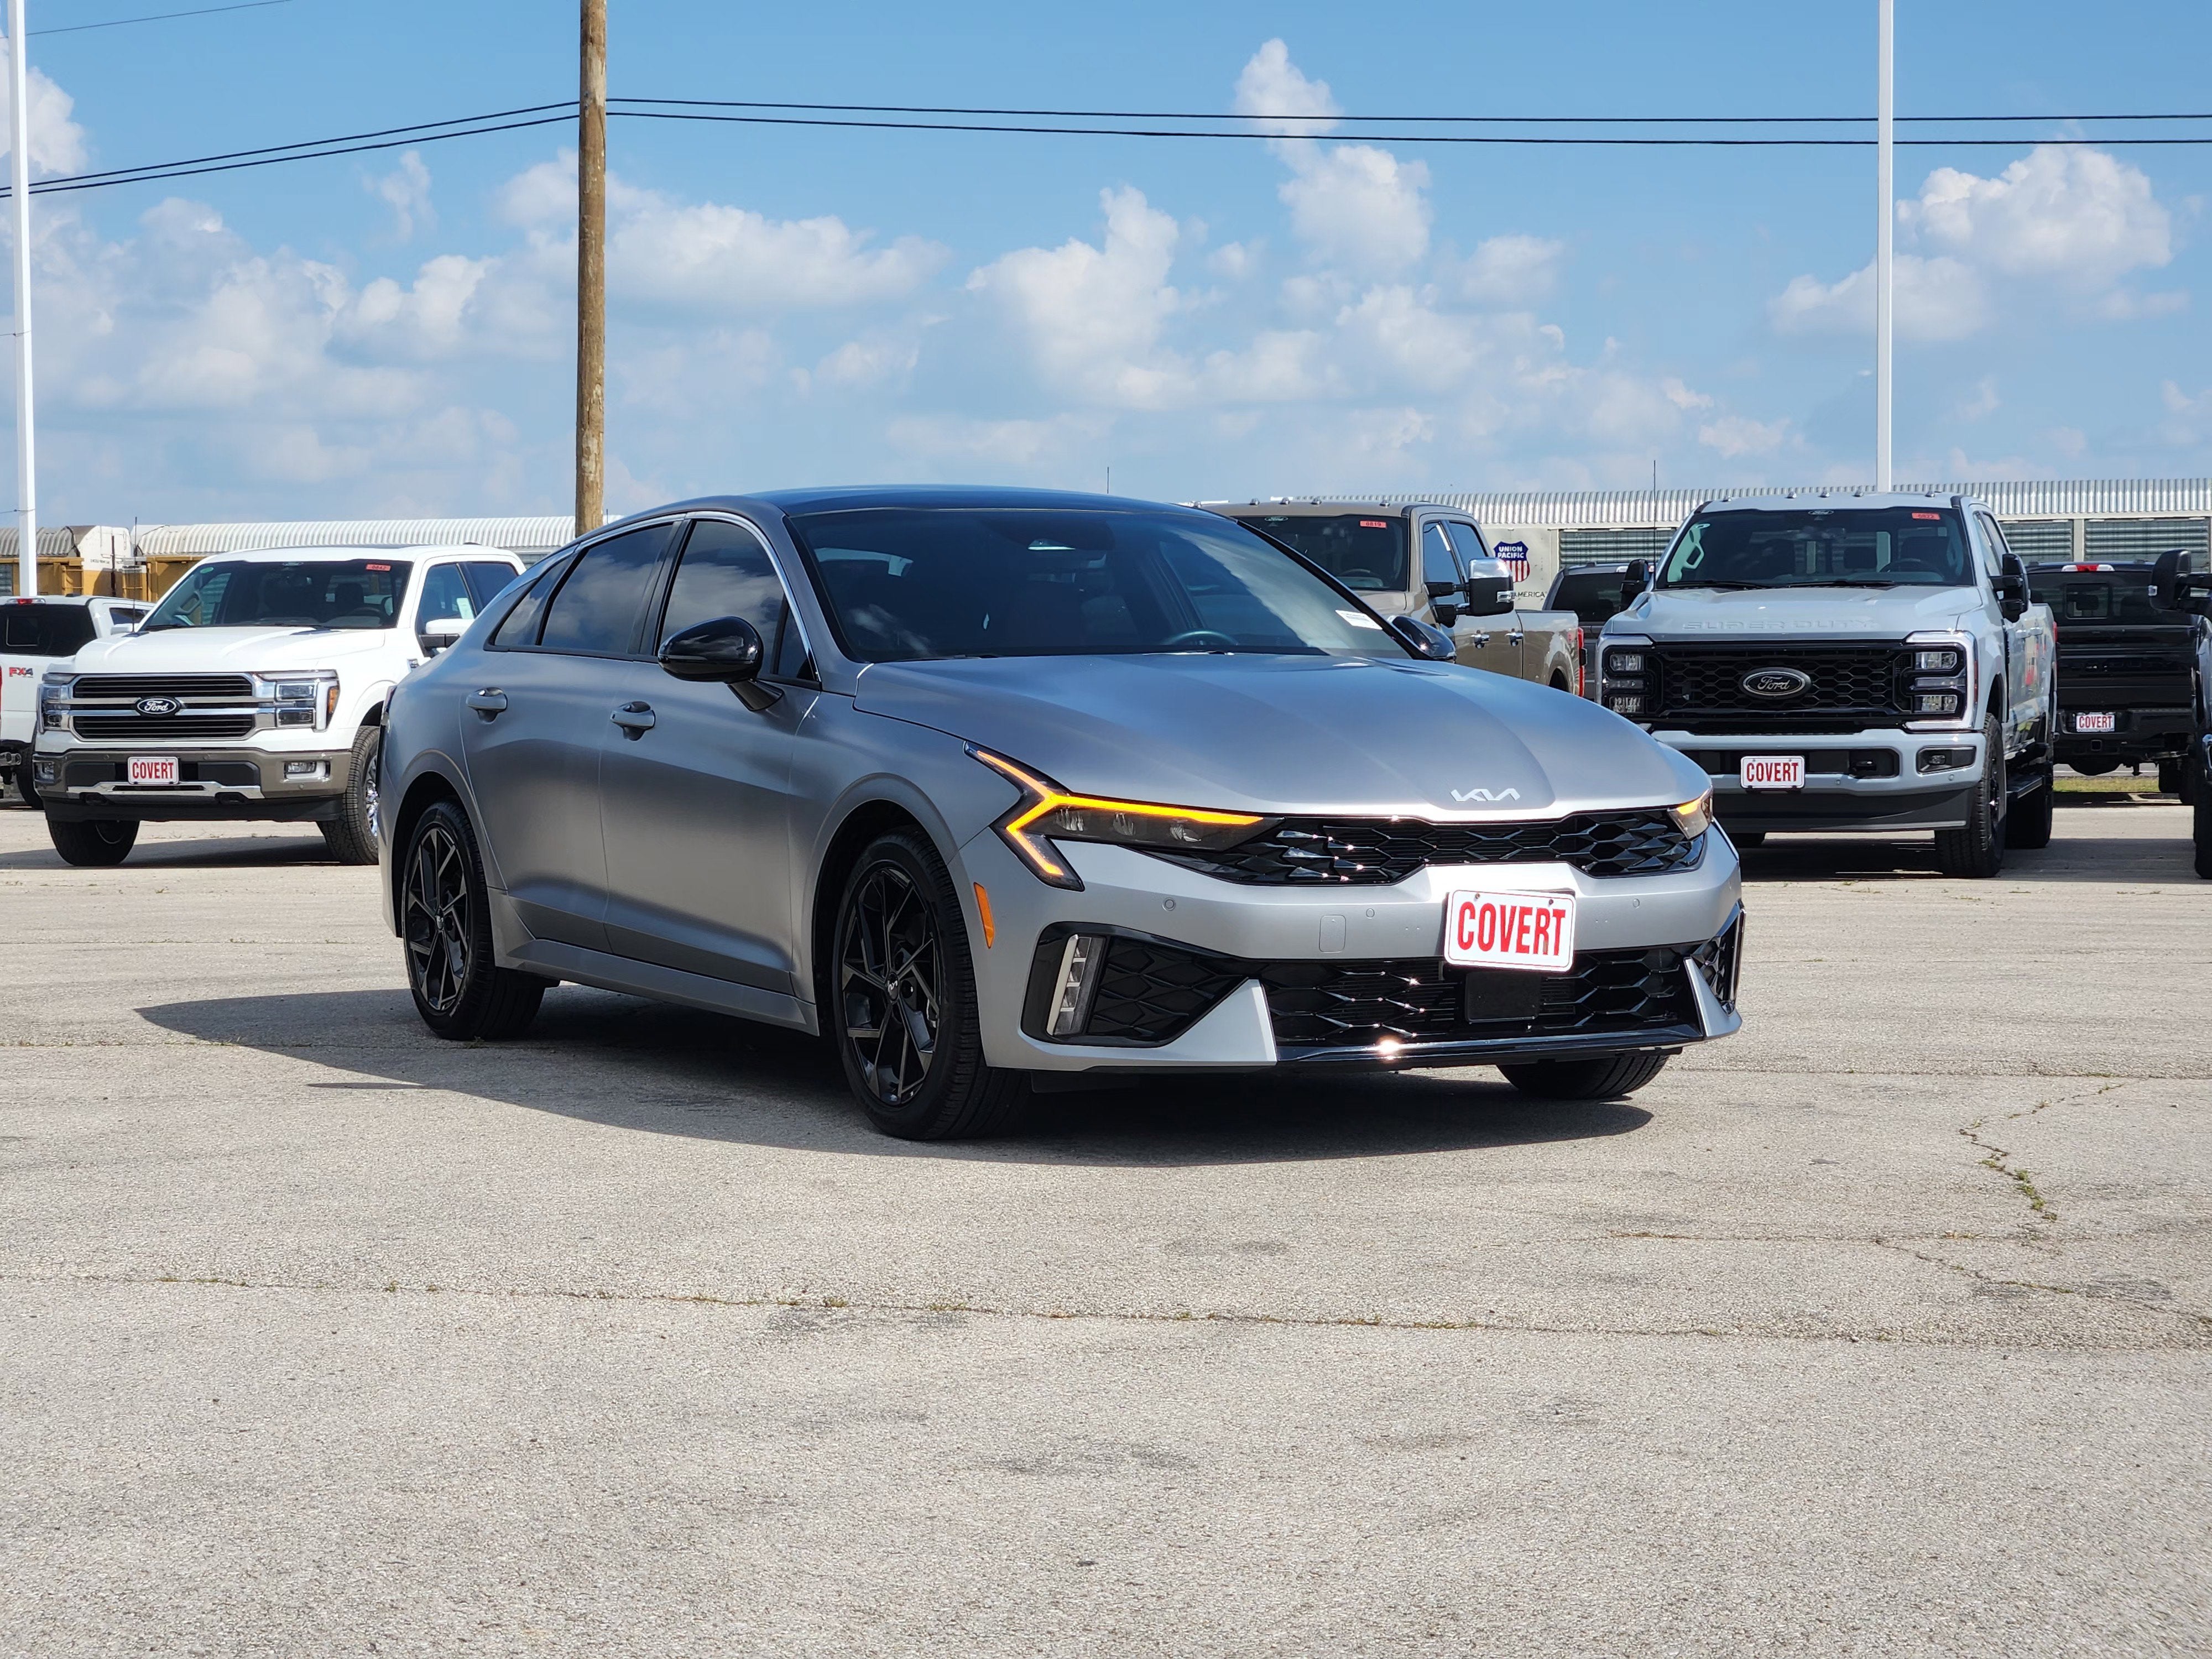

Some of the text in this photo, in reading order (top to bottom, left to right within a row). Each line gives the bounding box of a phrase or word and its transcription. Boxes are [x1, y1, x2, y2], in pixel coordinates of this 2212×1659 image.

[1682, 621, 1786, 630] SUPER
[9, 667, 33, 677] FX4
[1757, 676, 1791, 690] Ford
[144, 700, 169, 711] Ford
[2079, 716, 2112, 728] COVERT
[132, 762, 174, 779] COVERT
[1746, 762, 1799, 782] COVERT
[1457, 901, 1566, 956] COVERT
